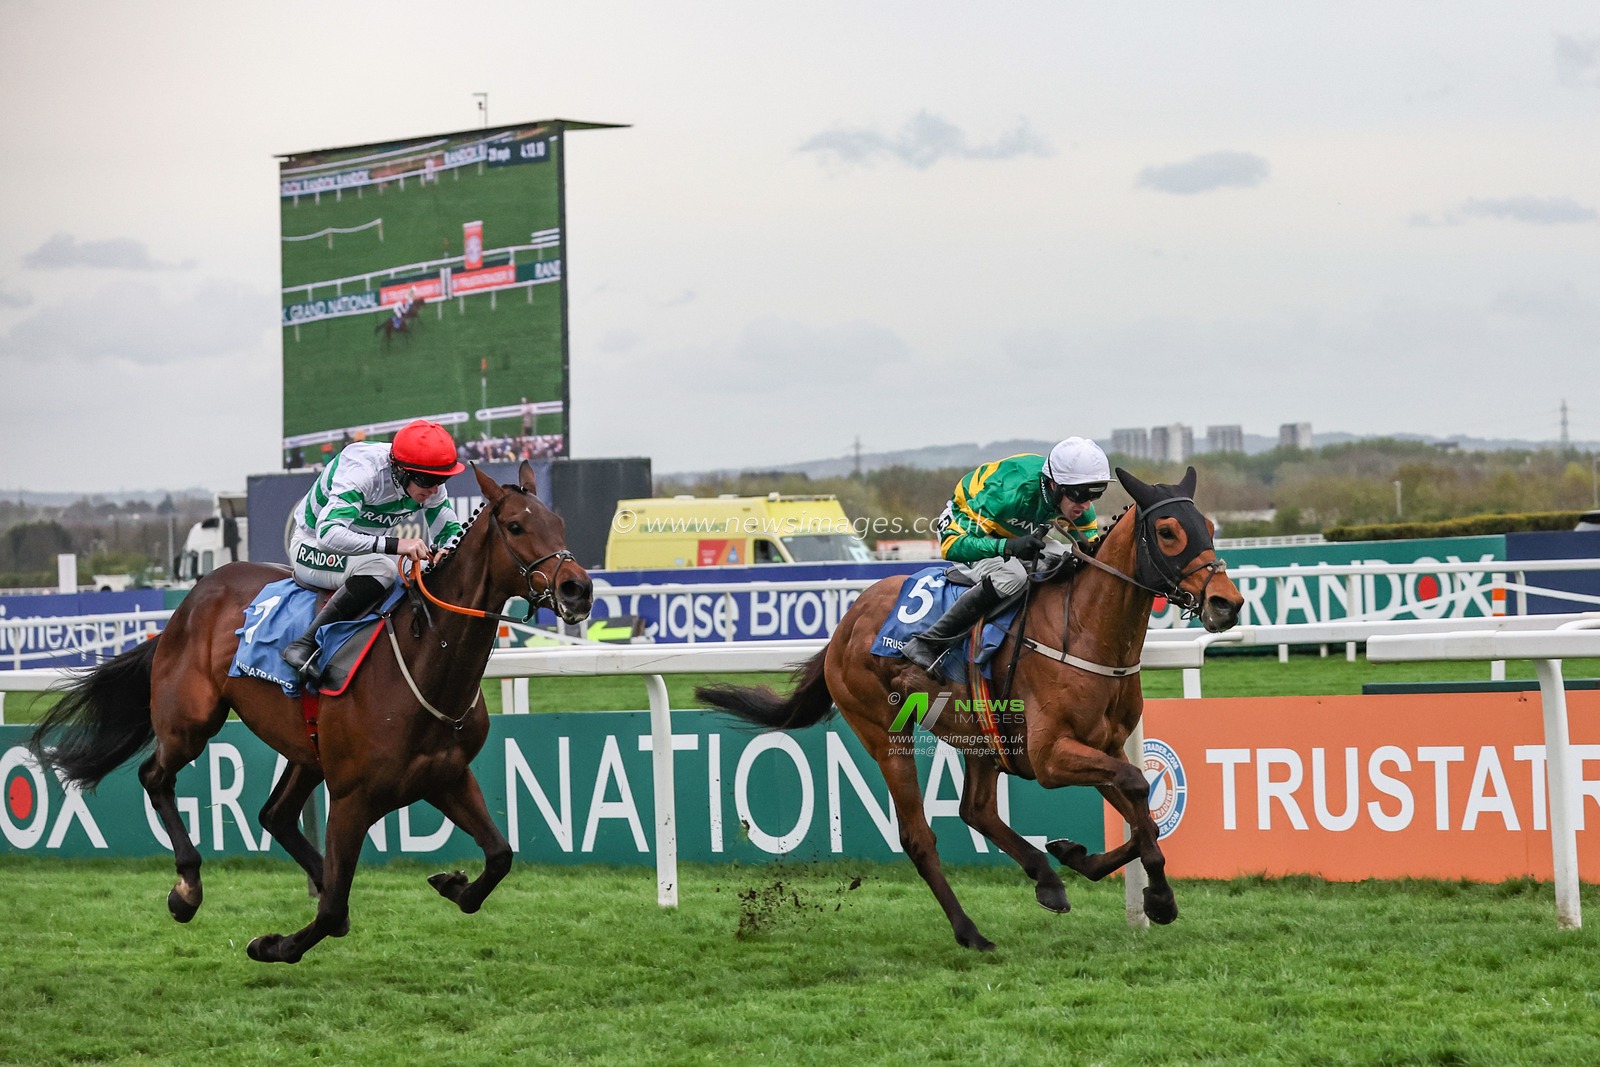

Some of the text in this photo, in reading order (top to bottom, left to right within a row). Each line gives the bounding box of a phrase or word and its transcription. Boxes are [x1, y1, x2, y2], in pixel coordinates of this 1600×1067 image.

[290, 301, 326, 319] GRAND
[328, 292, 378, 313] NATIONAL
[299, 546, 345, 569] RANDOX
[630, 582, 738, 639] Close
[898, 575, 945, 624] 5
[1238, 553, 1494, 625] RANDOX
[245, 596, 281, 645] 7
